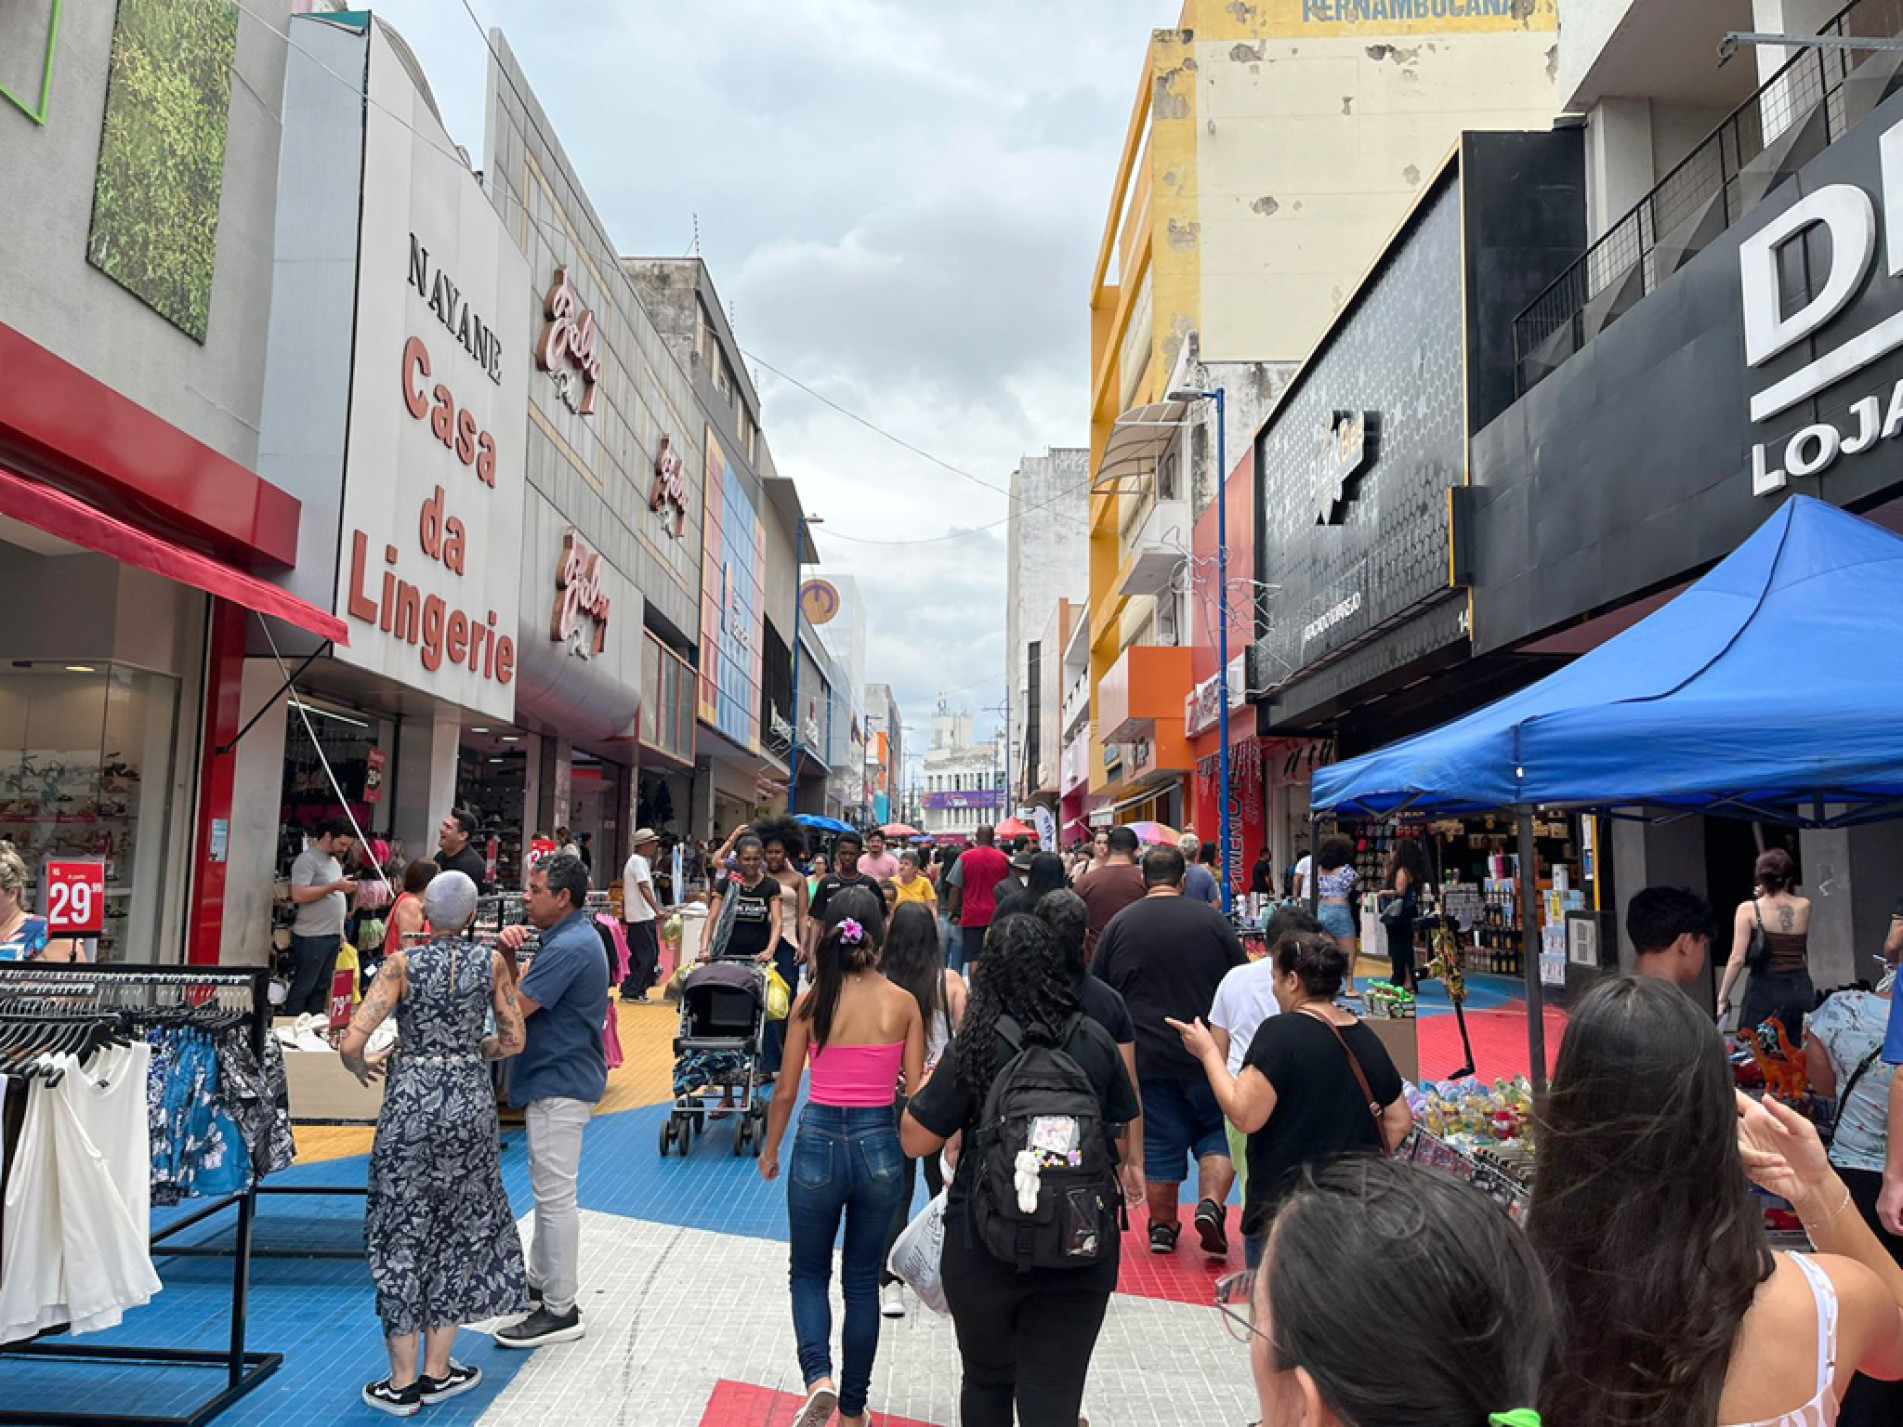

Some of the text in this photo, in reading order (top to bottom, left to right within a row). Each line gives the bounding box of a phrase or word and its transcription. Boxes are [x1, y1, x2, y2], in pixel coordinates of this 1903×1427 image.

[407, 231, 503, 386] NAYANE
[401, 335, 497, 489] Casa
[419, 484, 466, 576] da
[348, 530, 516, 685] Lingerie
